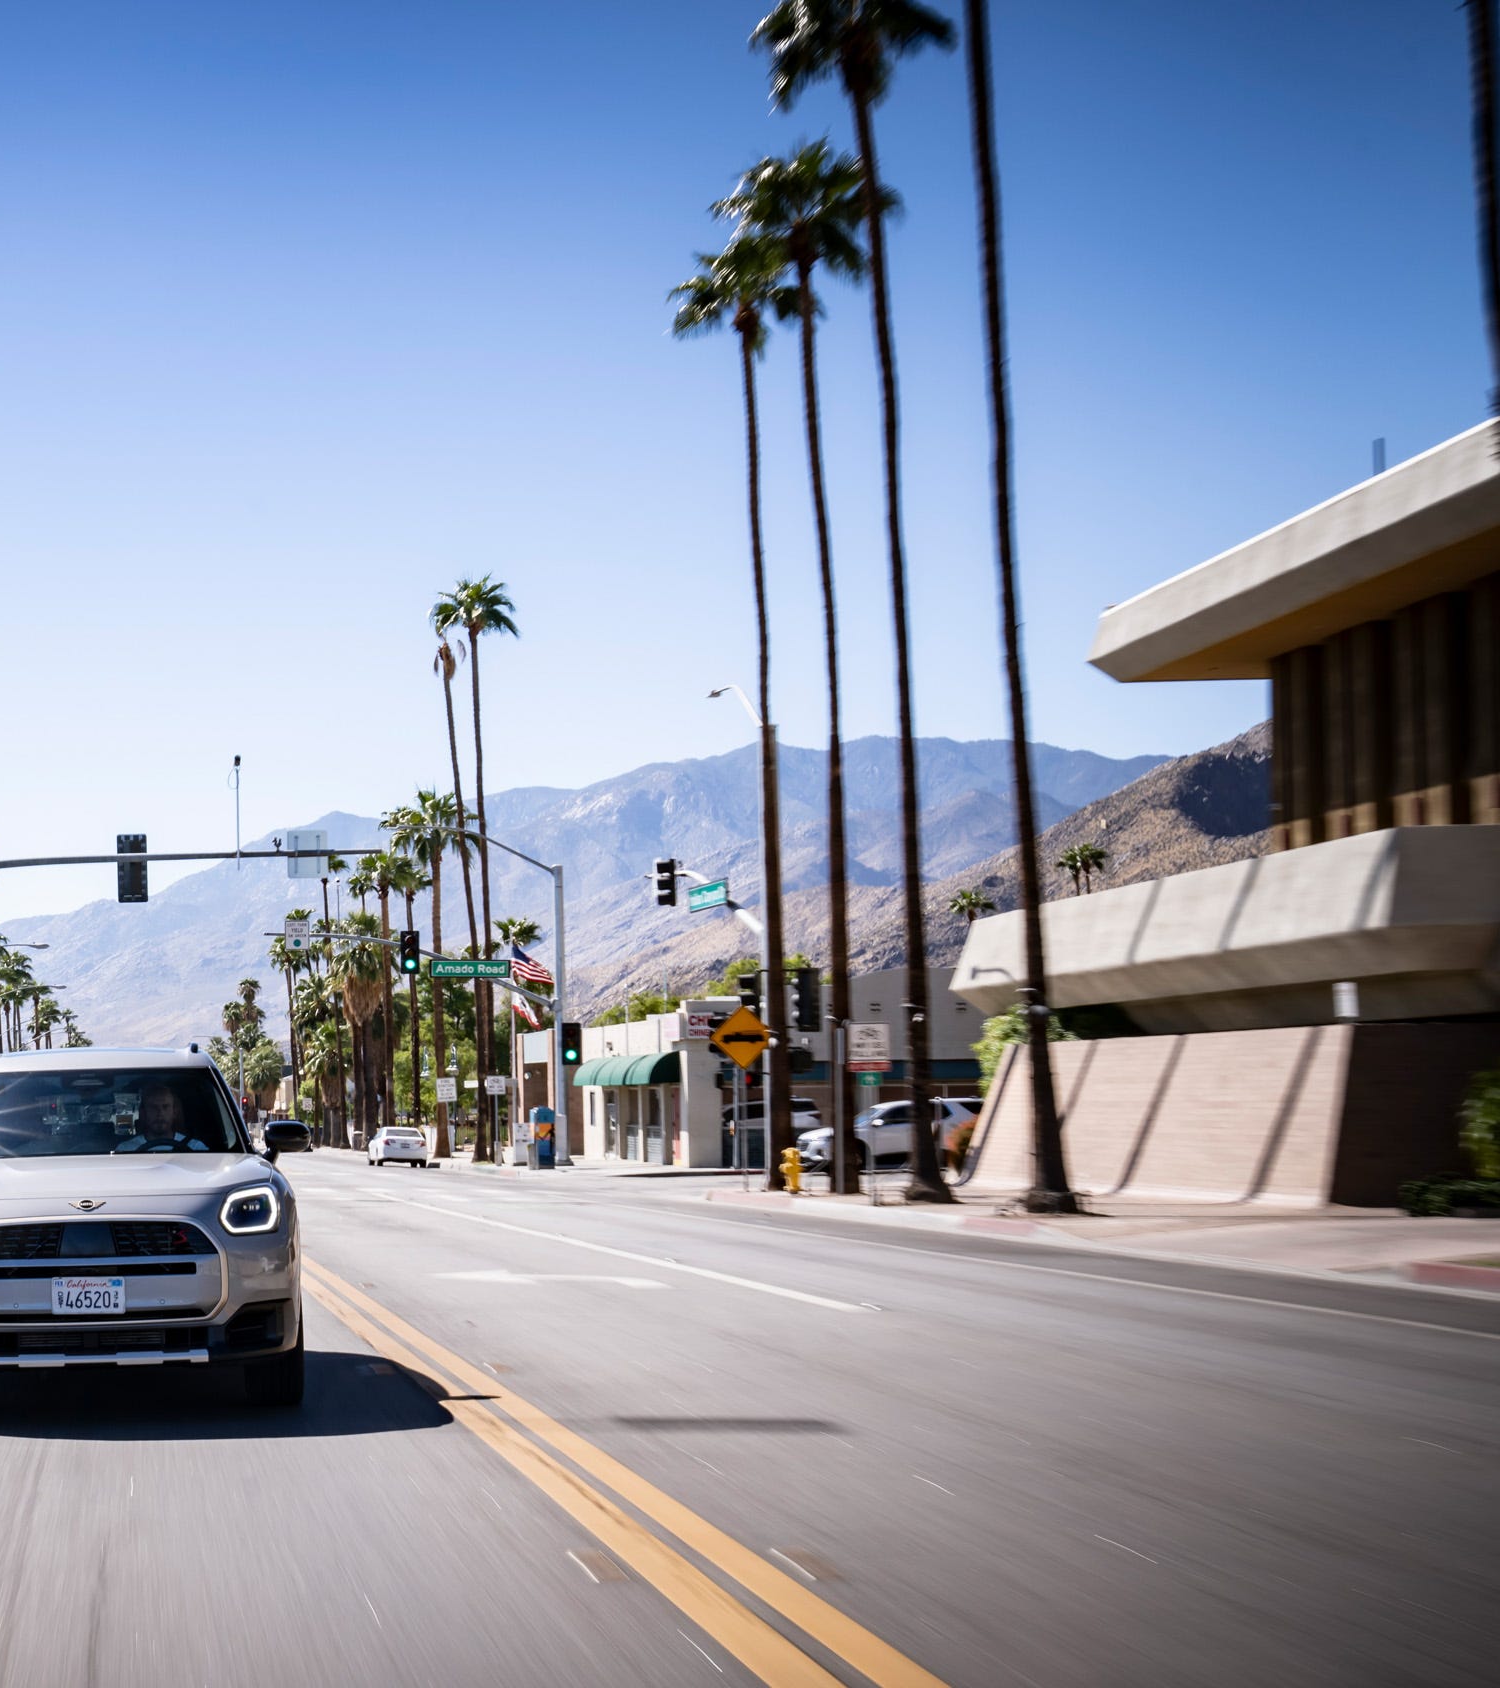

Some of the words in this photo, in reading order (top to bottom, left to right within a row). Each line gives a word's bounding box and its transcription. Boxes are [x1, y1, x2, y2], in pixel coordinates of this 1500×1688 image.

[436, 964, 474, 974] Amado
[478, 964, 506, 974] Road
[66, 1279, 108, 1290] California
[65, 1290, 111, 1309] 46520
